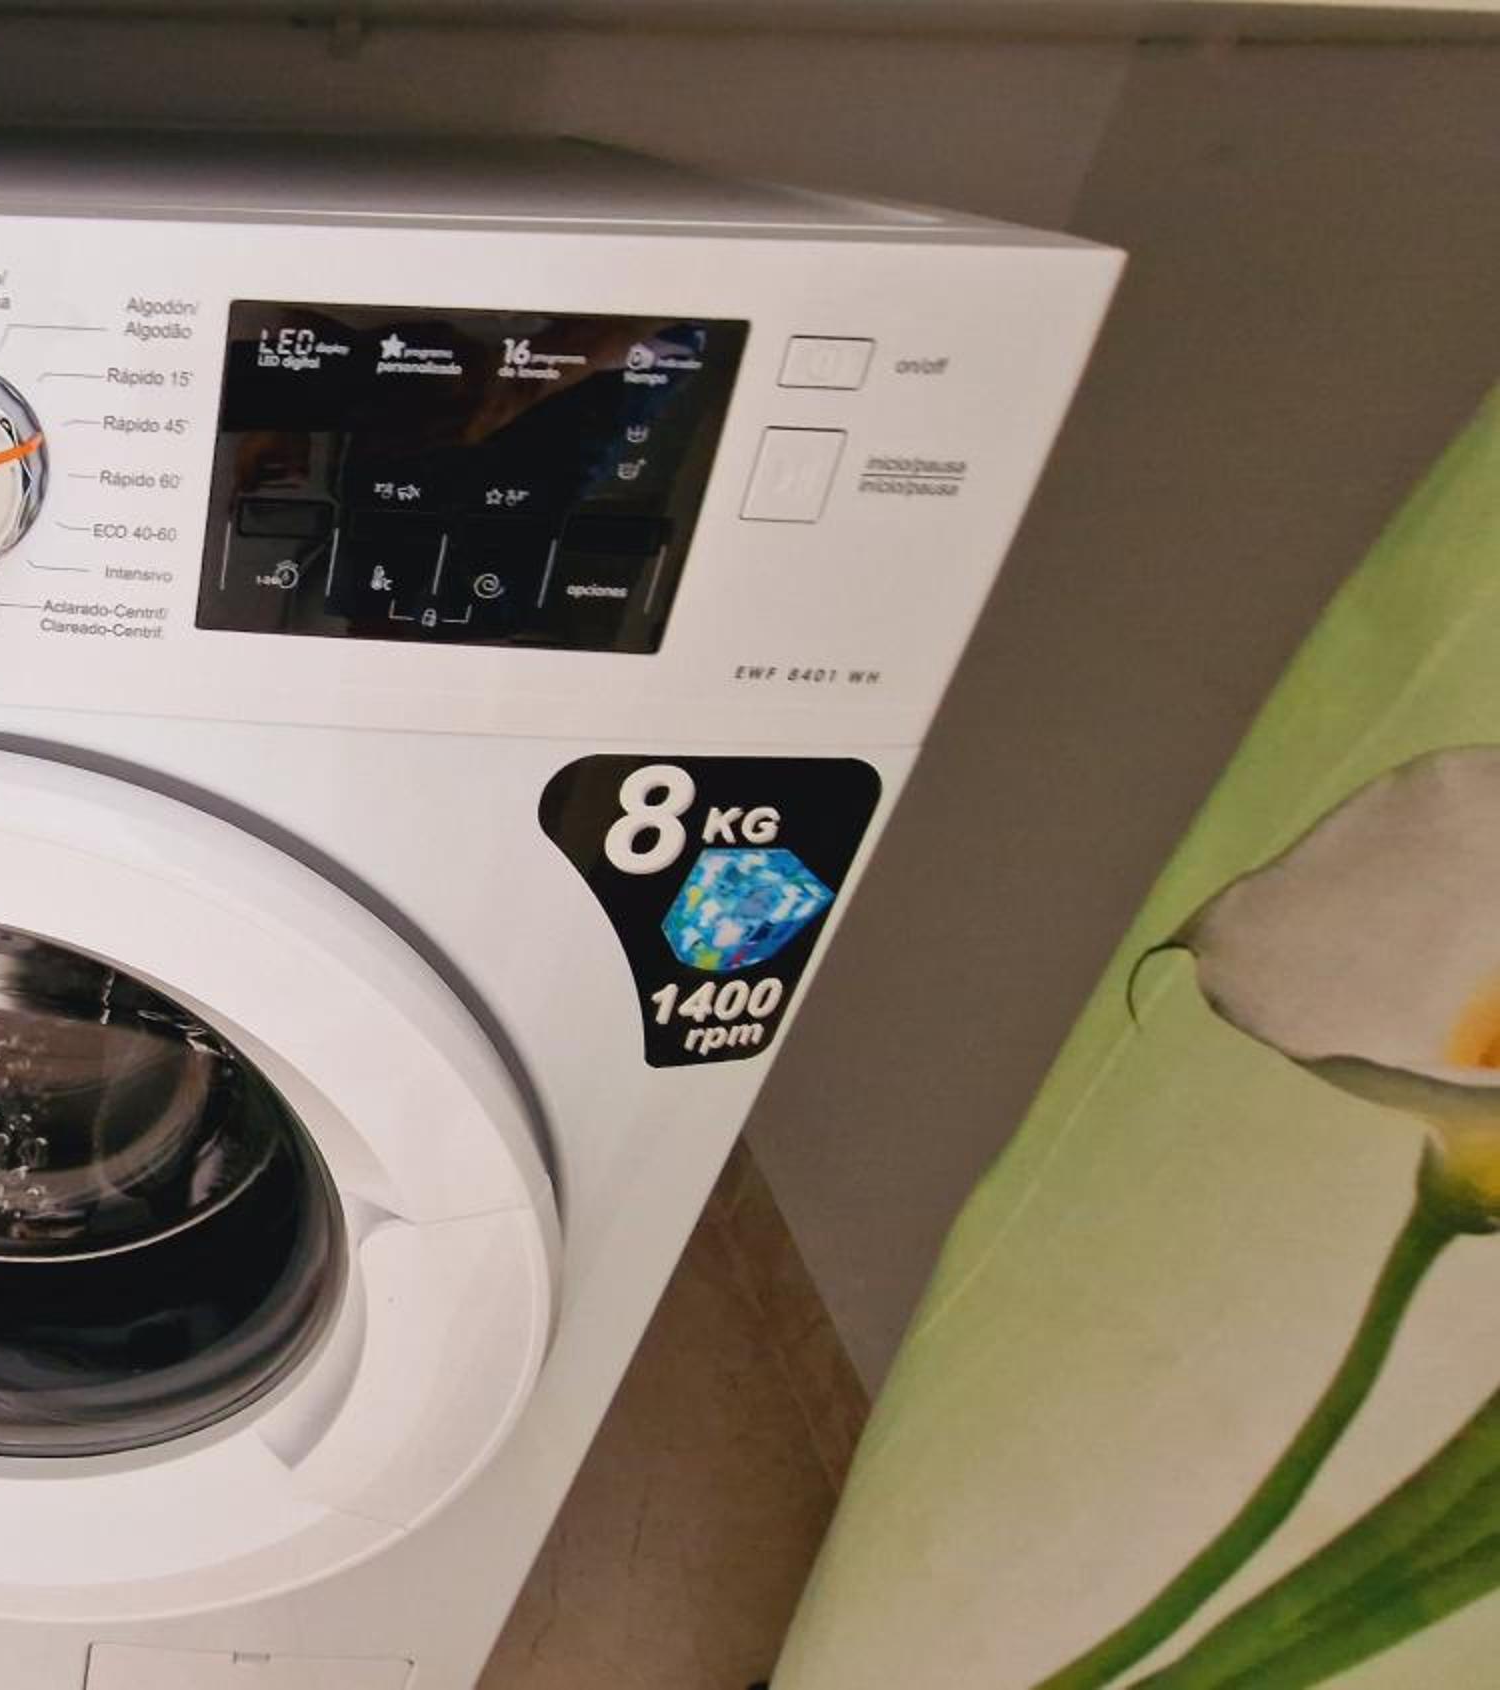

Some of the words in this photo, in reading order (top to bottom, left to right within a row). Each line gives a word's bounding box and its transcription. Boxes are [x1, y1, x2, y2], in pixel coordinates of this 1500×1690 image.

[124, 320, 192, 341] Algodão
[259, 328, 315, 356] LED
[503, 338, 531, 365] 16
[257, 354, 280, 367] LED
[282, 355, 321, 370] digital
[106, 367, 166, 387] Rápido
[102, 415, 161, 434] Rápido
[100, 470, 156, 488] Rápido
[93, 523, 127, 539] ECO
[133, 527, 178, 541] 40-60
[104, 566, 172, 583] Intensivo
[566, 584, 628, 599] opciones
[735, 664, 778, 681] EWF
[787, 667, 838, 684] 8401
[848, 670, 881, 685] WH
[605, 764, 697, 875] 8
[702, 807, 782, 844] KG
[651, 977, 784, 1025] 1400
[684, 1022, 765, 1056] rpm
